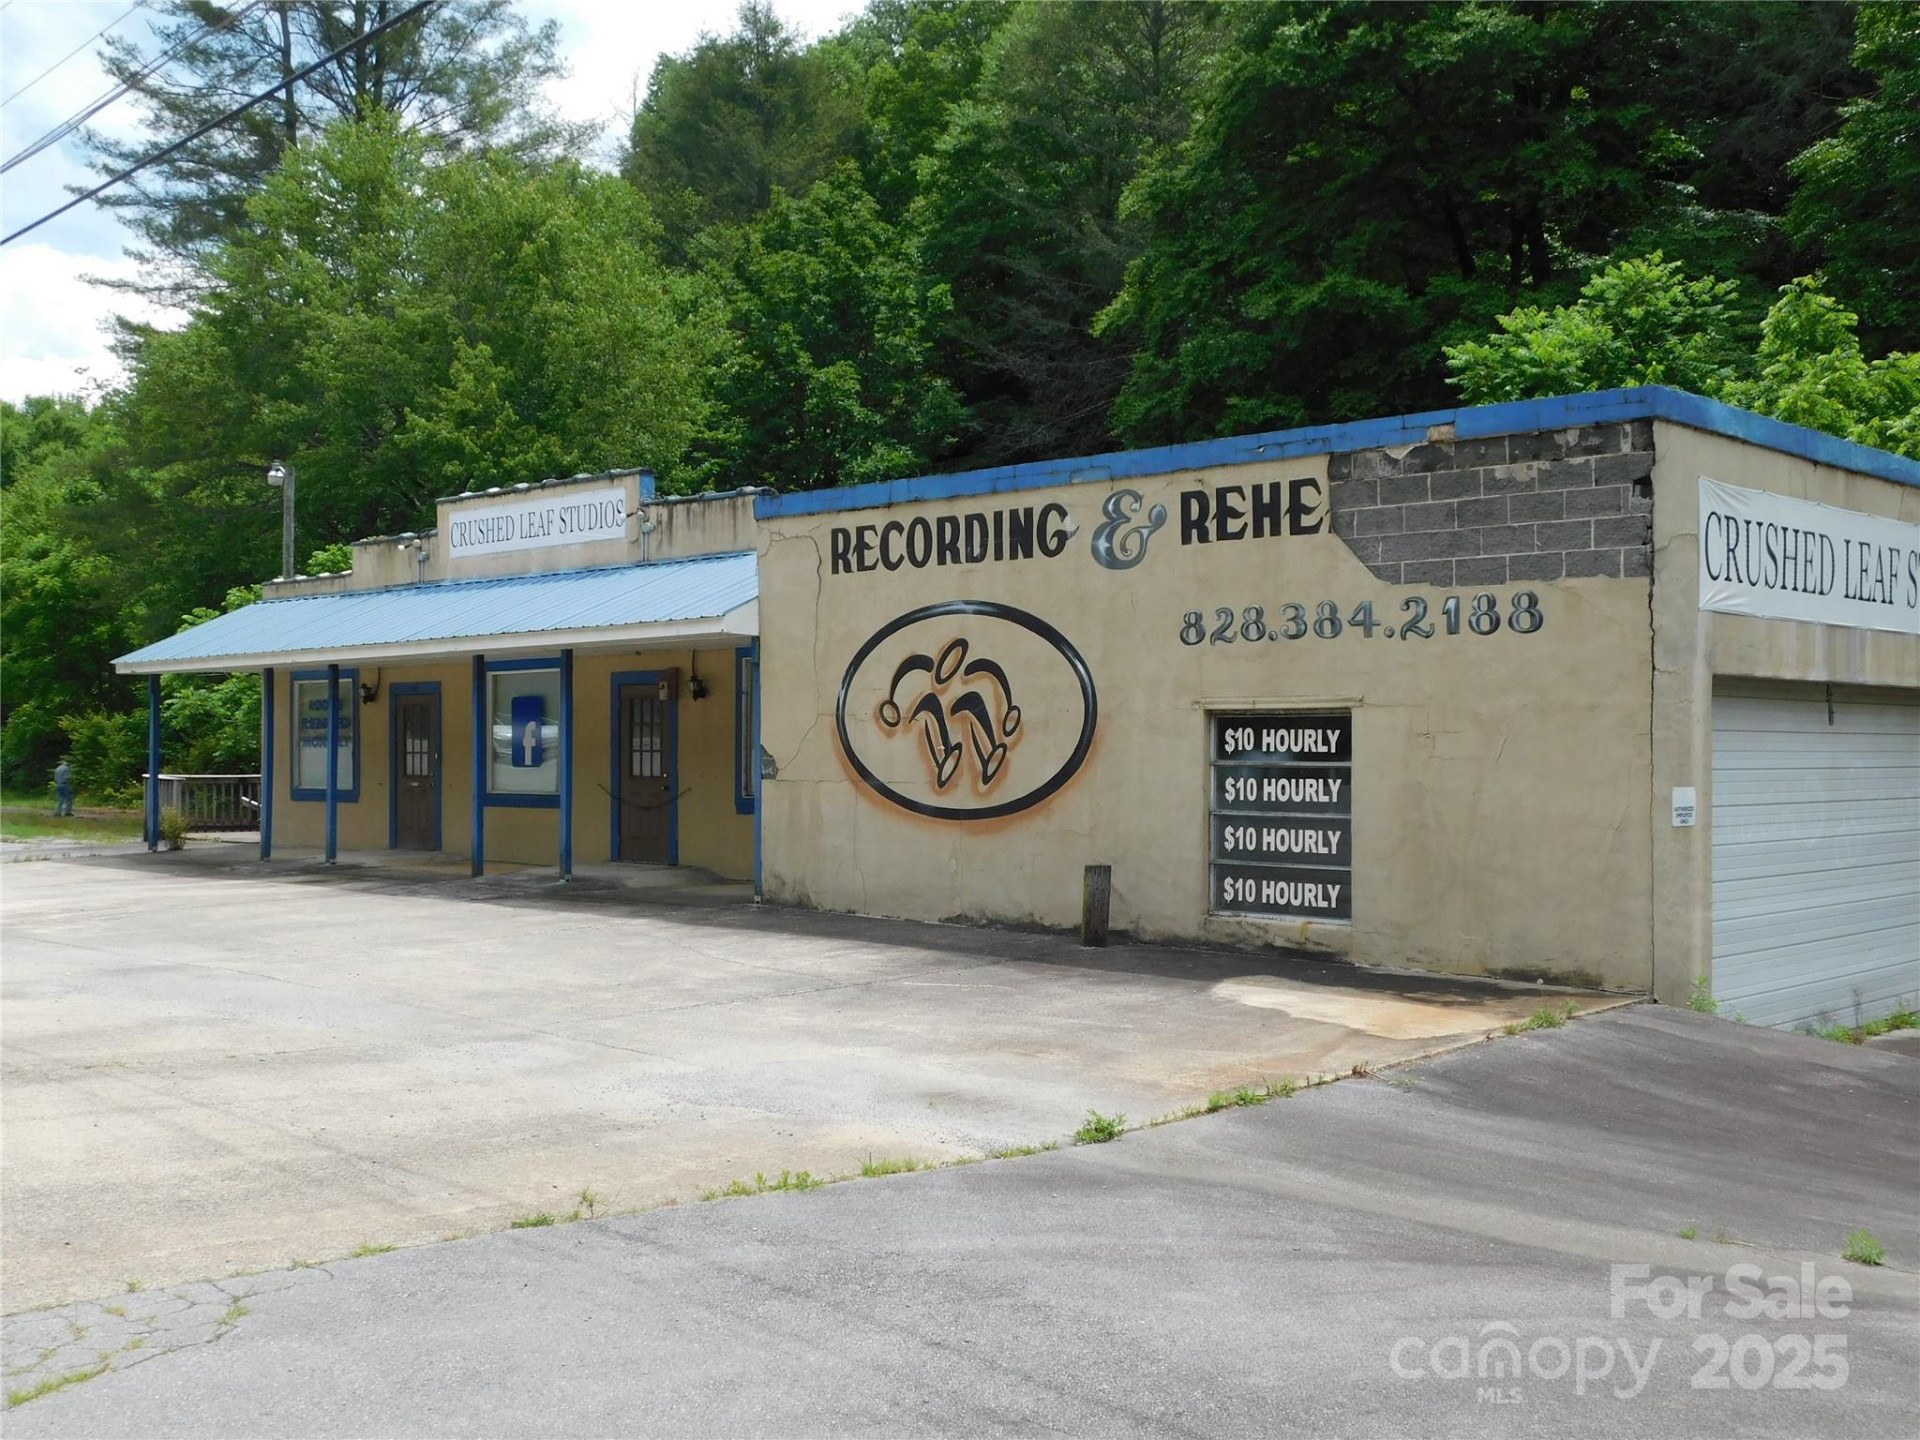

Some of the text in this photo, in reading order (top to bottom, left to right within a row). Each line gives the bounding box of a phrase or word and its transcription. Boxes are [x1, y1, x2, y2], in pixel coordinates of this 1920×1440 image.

[450, 499, 625, 549] CRUSHED LEAF STUDIOS
[830, 477, 1333, 575] RECORDING & REHE
[1704, 510, 1836, 597] CRUSHED
[1843, 538, 1901, 606] LEAF
[1179, 589, 1545, 647] 828.384.2188
[1224, 727, 1341, 756] $10 HOURLY
[1224, 776, 1342, 804] $10 HOURLY
[1223, 825, 1342, 855] $10 HOURLY
[1223, 876, 1341, 909] $10 HOURLY
